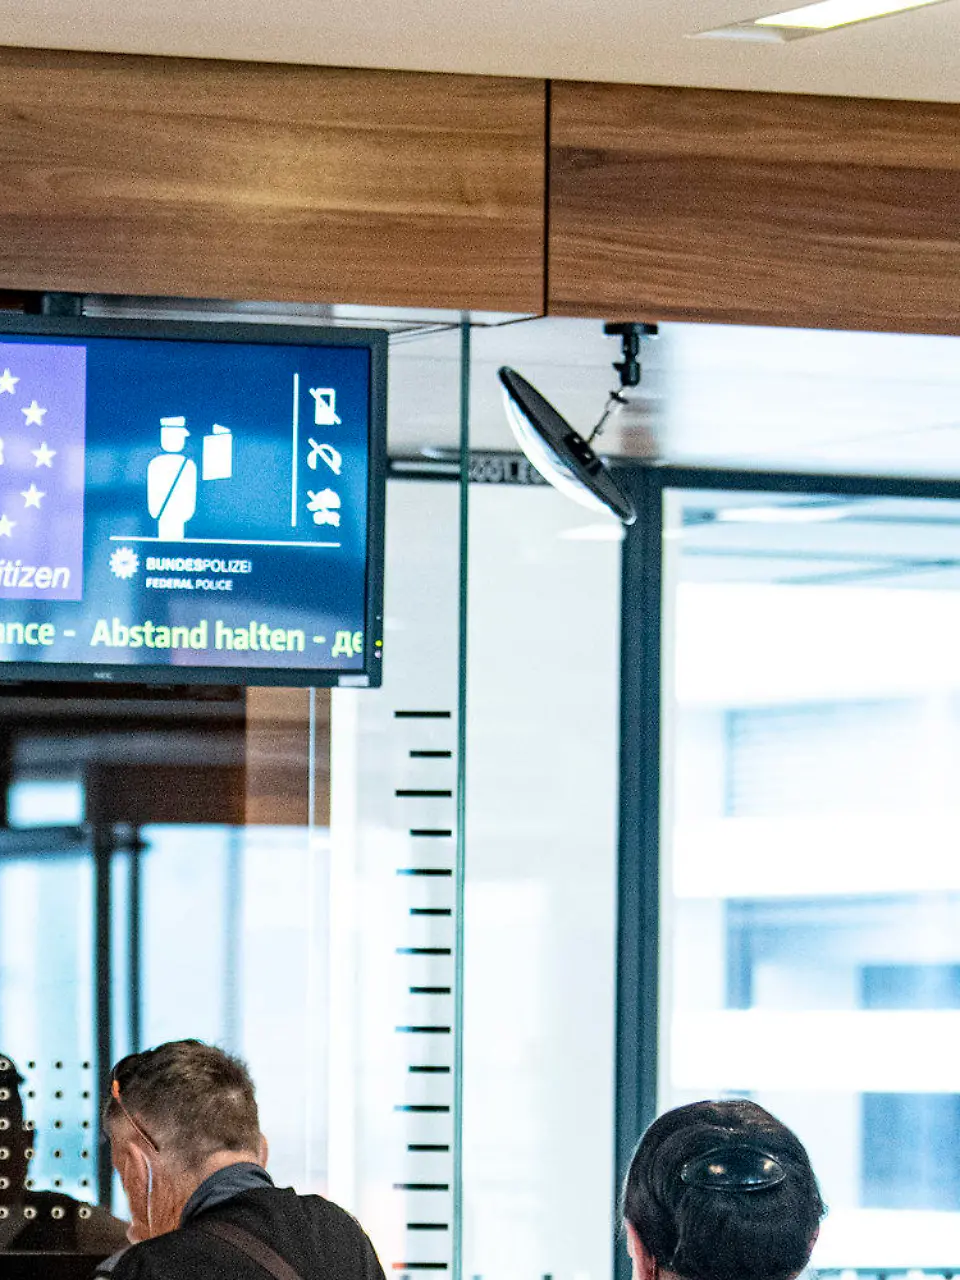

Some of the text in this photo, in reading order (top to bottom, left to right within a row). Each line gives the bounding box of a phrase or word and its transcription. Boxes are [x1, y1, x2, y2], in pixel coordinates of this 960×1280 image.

[145, 557, 253, 573] BUNDESPOLIZEI
[145, 577, 233, 591] FEDERAL POLICE
[90, 617, 208, 649] Abstand
[214, 619, 306, 652] halten
